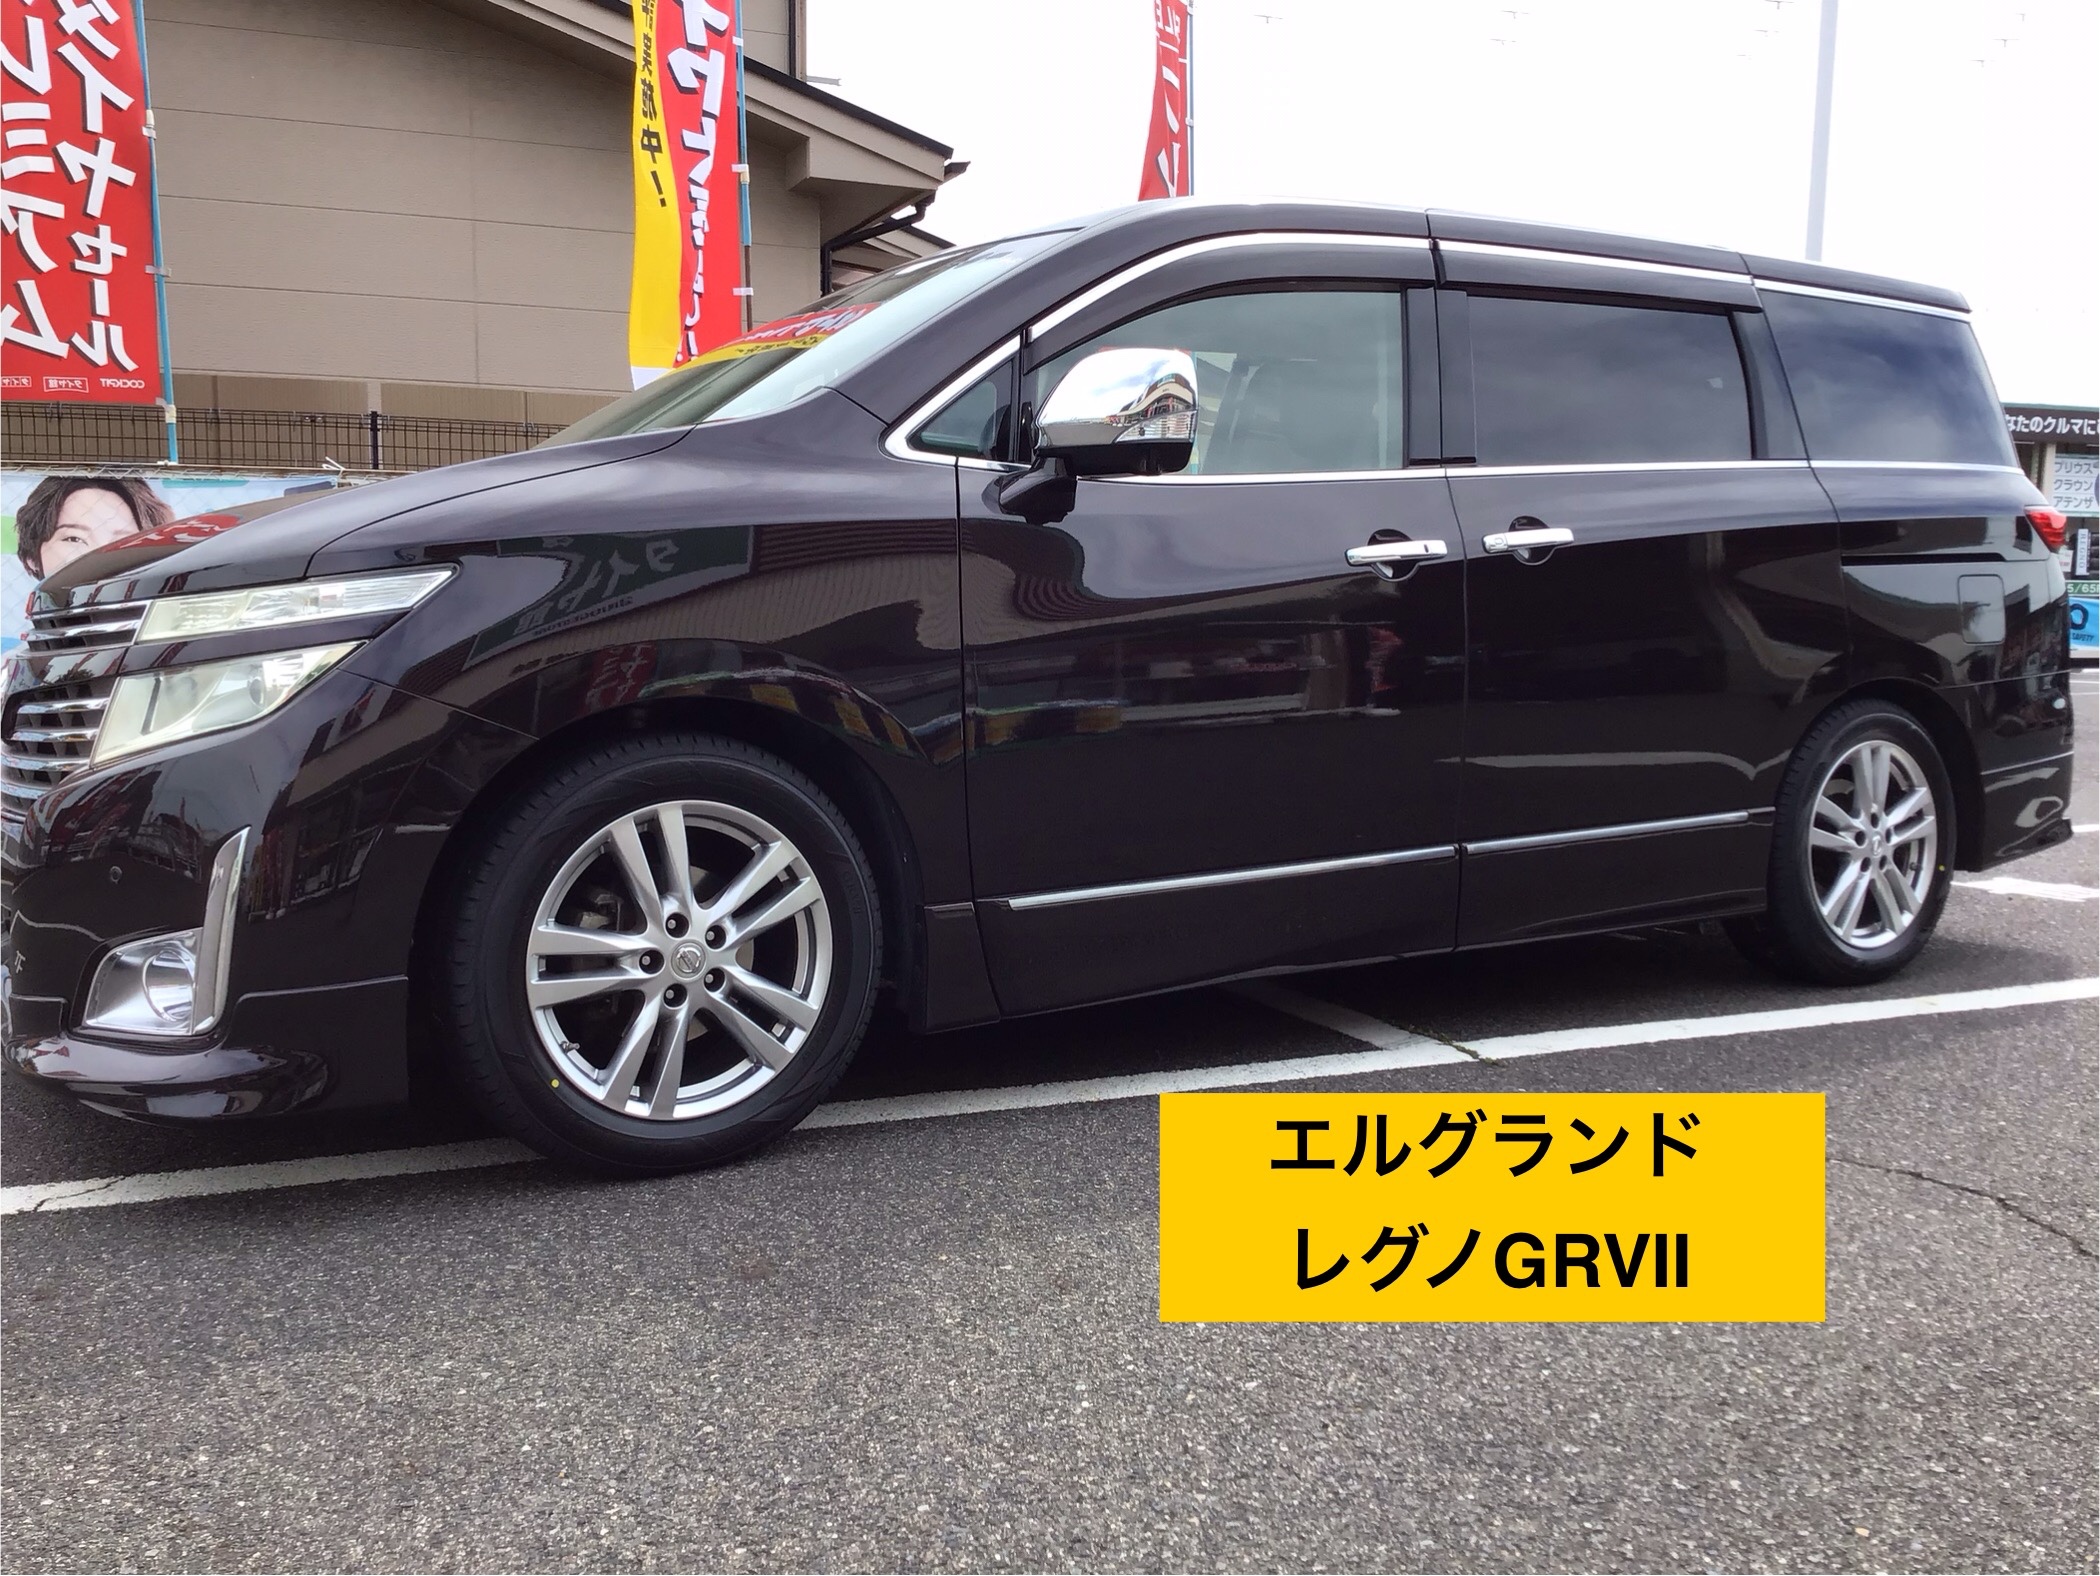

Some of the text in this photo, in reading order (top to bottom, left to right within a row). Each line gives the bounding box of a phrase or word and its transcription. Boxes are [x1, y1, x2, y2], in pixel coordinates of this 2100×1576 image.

[2005, 414, 2099, 435] なたのクルマに
[2053, 479, 2093, 492] クラウン
[2067, 583, 2099, 594] 5/65
